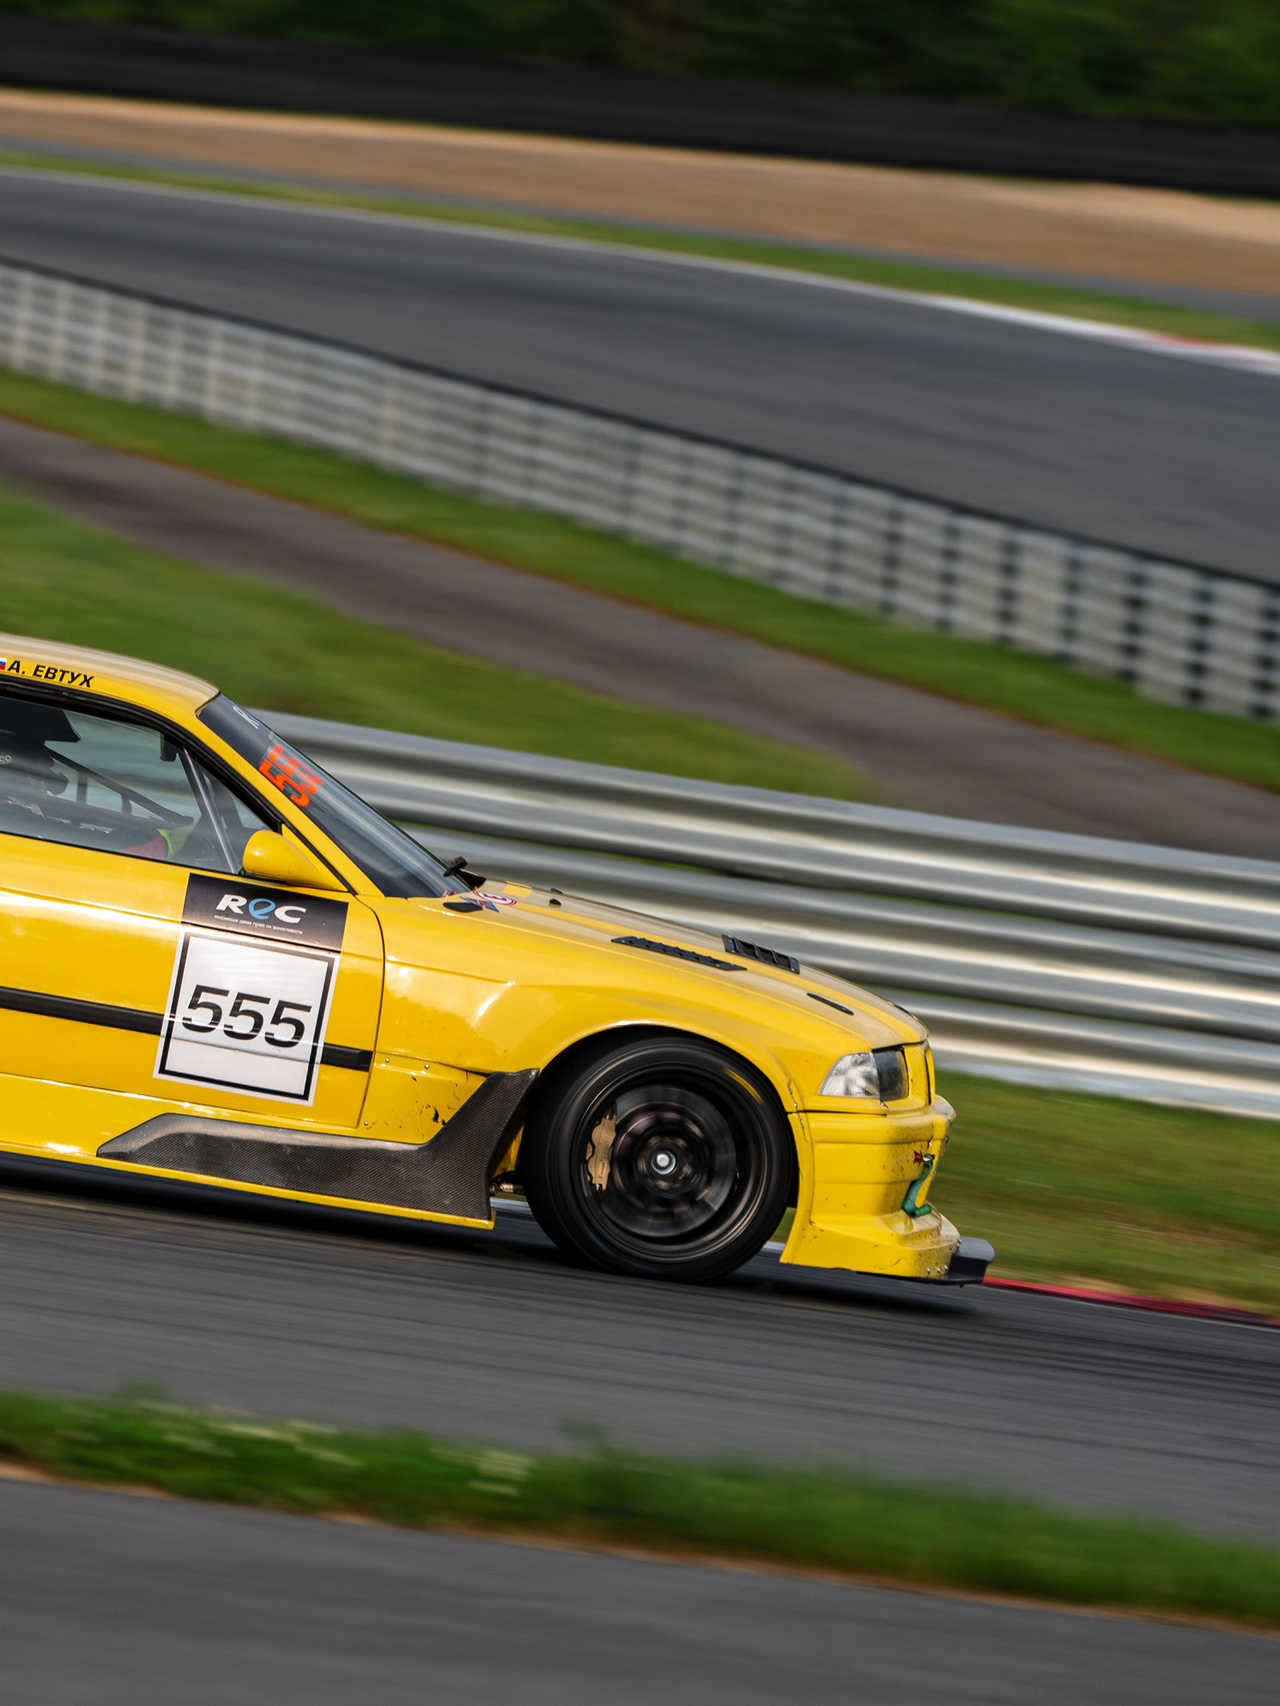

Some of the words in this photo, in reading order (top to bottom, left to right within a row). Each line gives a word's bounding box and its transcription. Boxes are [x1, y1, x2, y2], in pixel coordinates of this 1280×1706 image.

[7, 660, 26, 675] А.
[32, 663, 96, 688] ЕВТУХ
[258, 744, 323, 808] 555
[181, 984, 313, 1048] 555
